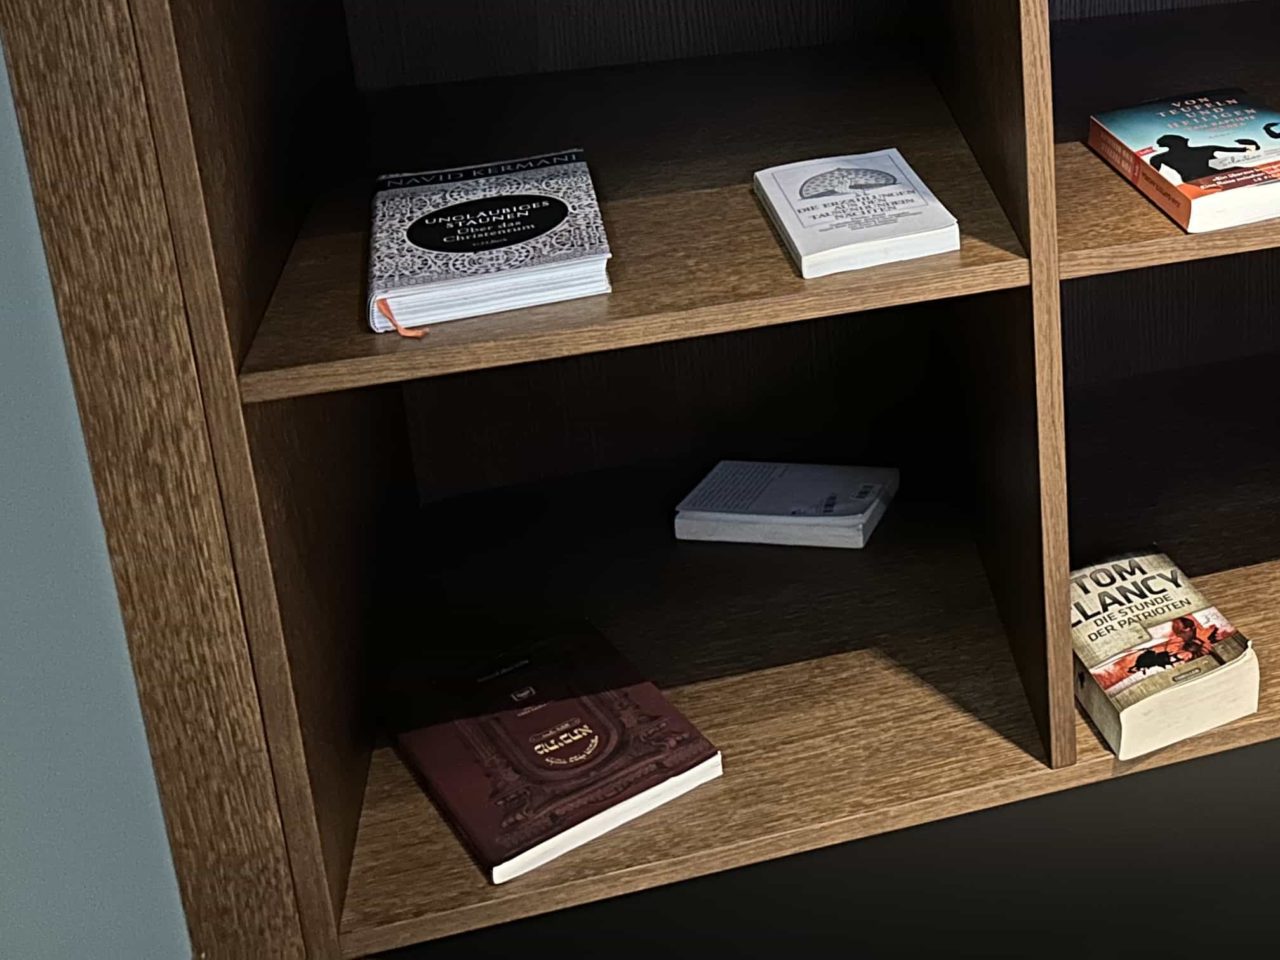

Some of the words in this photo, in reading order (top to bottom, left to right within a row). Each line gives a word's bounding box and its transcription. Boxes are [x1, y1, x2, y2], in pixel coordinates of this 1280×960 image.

[387, 171, 464, 188] NAVID
[472, 153, 577, 178] KERMANI
[446, 210, 529, 229] STAUNEN
[1072, 558, 1147, 595] TOM
[1087, 625, 1117, 643] DER
[1119, 598, 1192, 629] PATRIOTEN
[1093, 612, 1117, 628] DIE
[1117, 593, 1173, 617] STUNDE
